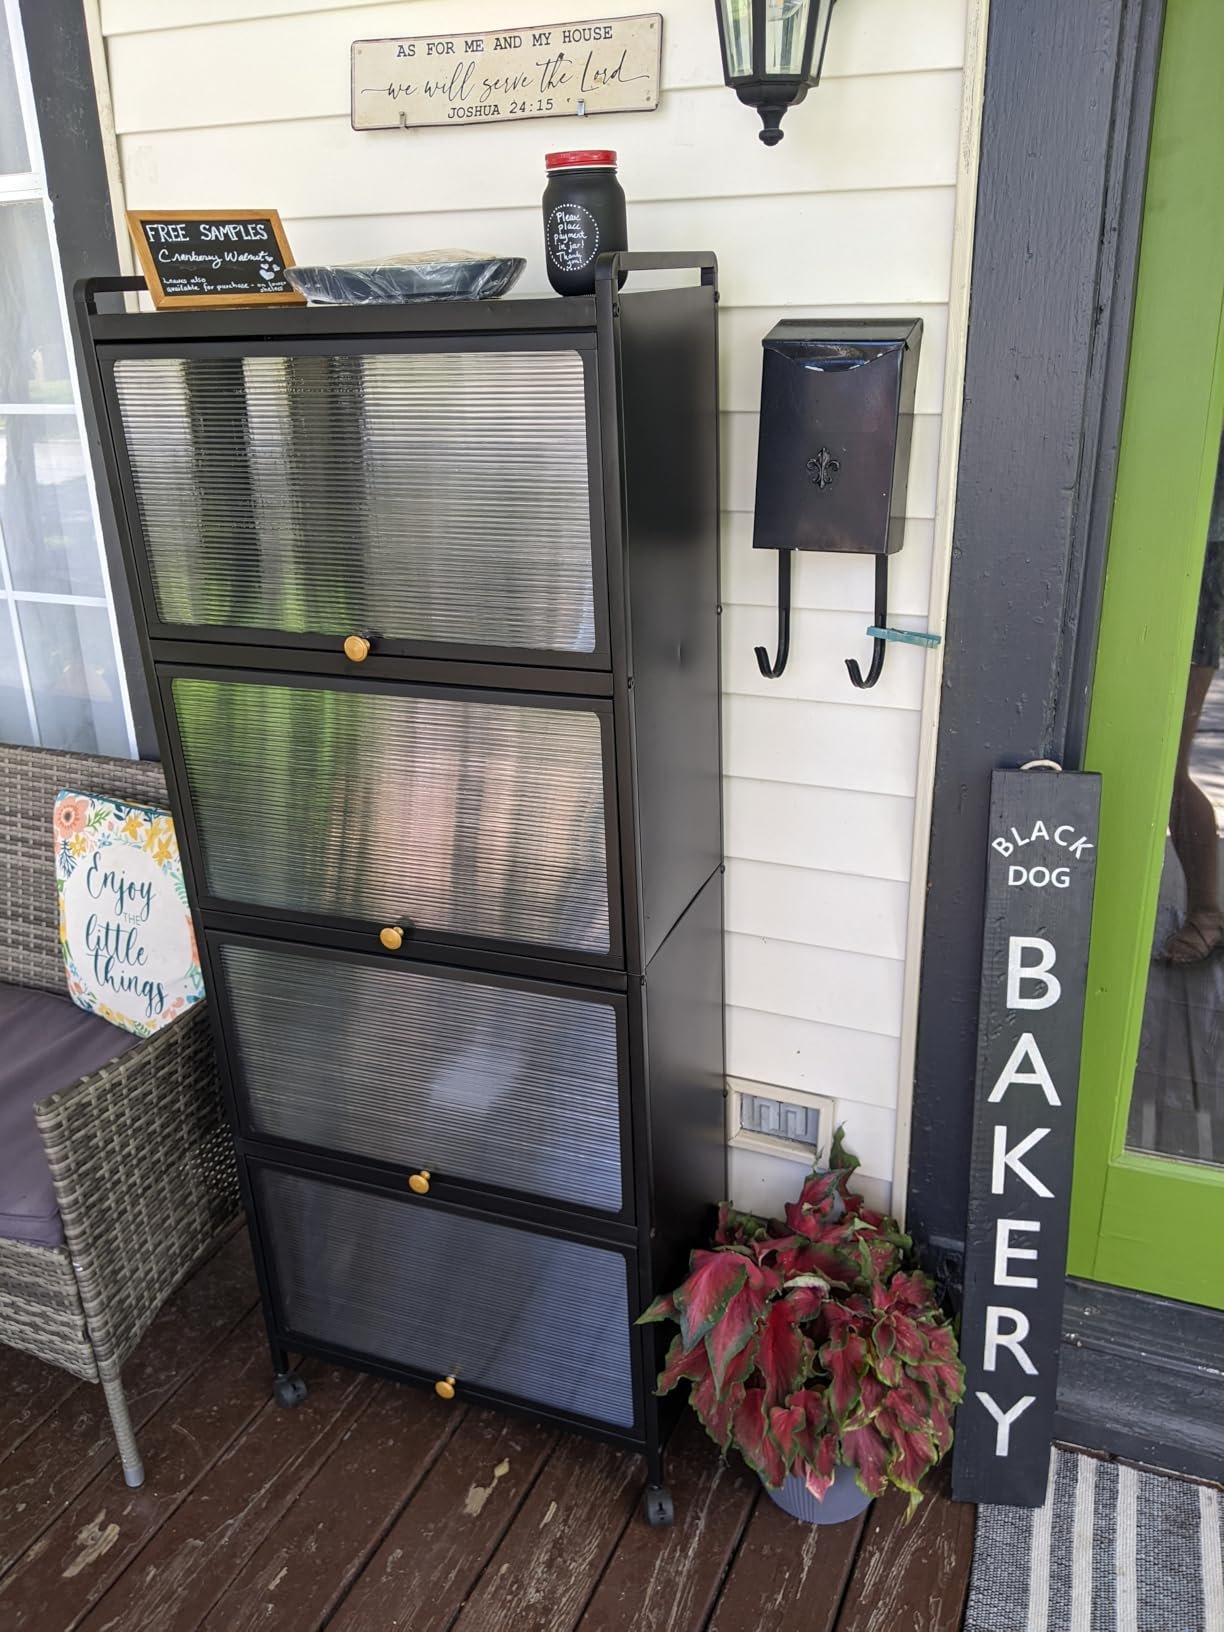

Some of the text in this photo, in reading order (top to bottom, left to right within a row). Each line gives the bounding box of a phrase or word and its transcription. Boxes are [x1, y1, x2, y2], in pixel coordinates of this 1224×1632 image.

[397, 26, 613, 58] AS FOR ME AND MY HOUSE
[424, 61, 476, 102] will
[479, 75, 533, 103] serve
[536, 52, 573, 94] the
[580, 49, 650, 93] Lord
[447, 98, 554, 120] JOSHUA 24:15
[556, 211, 581, 222] Please
[146, 224, 268, 242] FREE SAMPLES
[554, 231, 588, 245] payment
[558, 222, 581, 234] place
[556, 251, 582, 262] Thank
[568, 240, 584, 252] jar!
[158, 249, 268, 269] Cranberry Walnut
[166, 284, 200, 292] available
[203, 283, 214, 292] for
[216, 282, 250, 291] purchase
[992, 820, 1094, 860] BLACK
[86, 851, 156, 922] Enjoy
[1008, 866, 1070, 888] DOG
[124, 912, 140, 926] THE
[86, 913, 148, 966] little
[86, 948, 168, 1018] things
[975, 935, 1062, 1457] BAKERY
